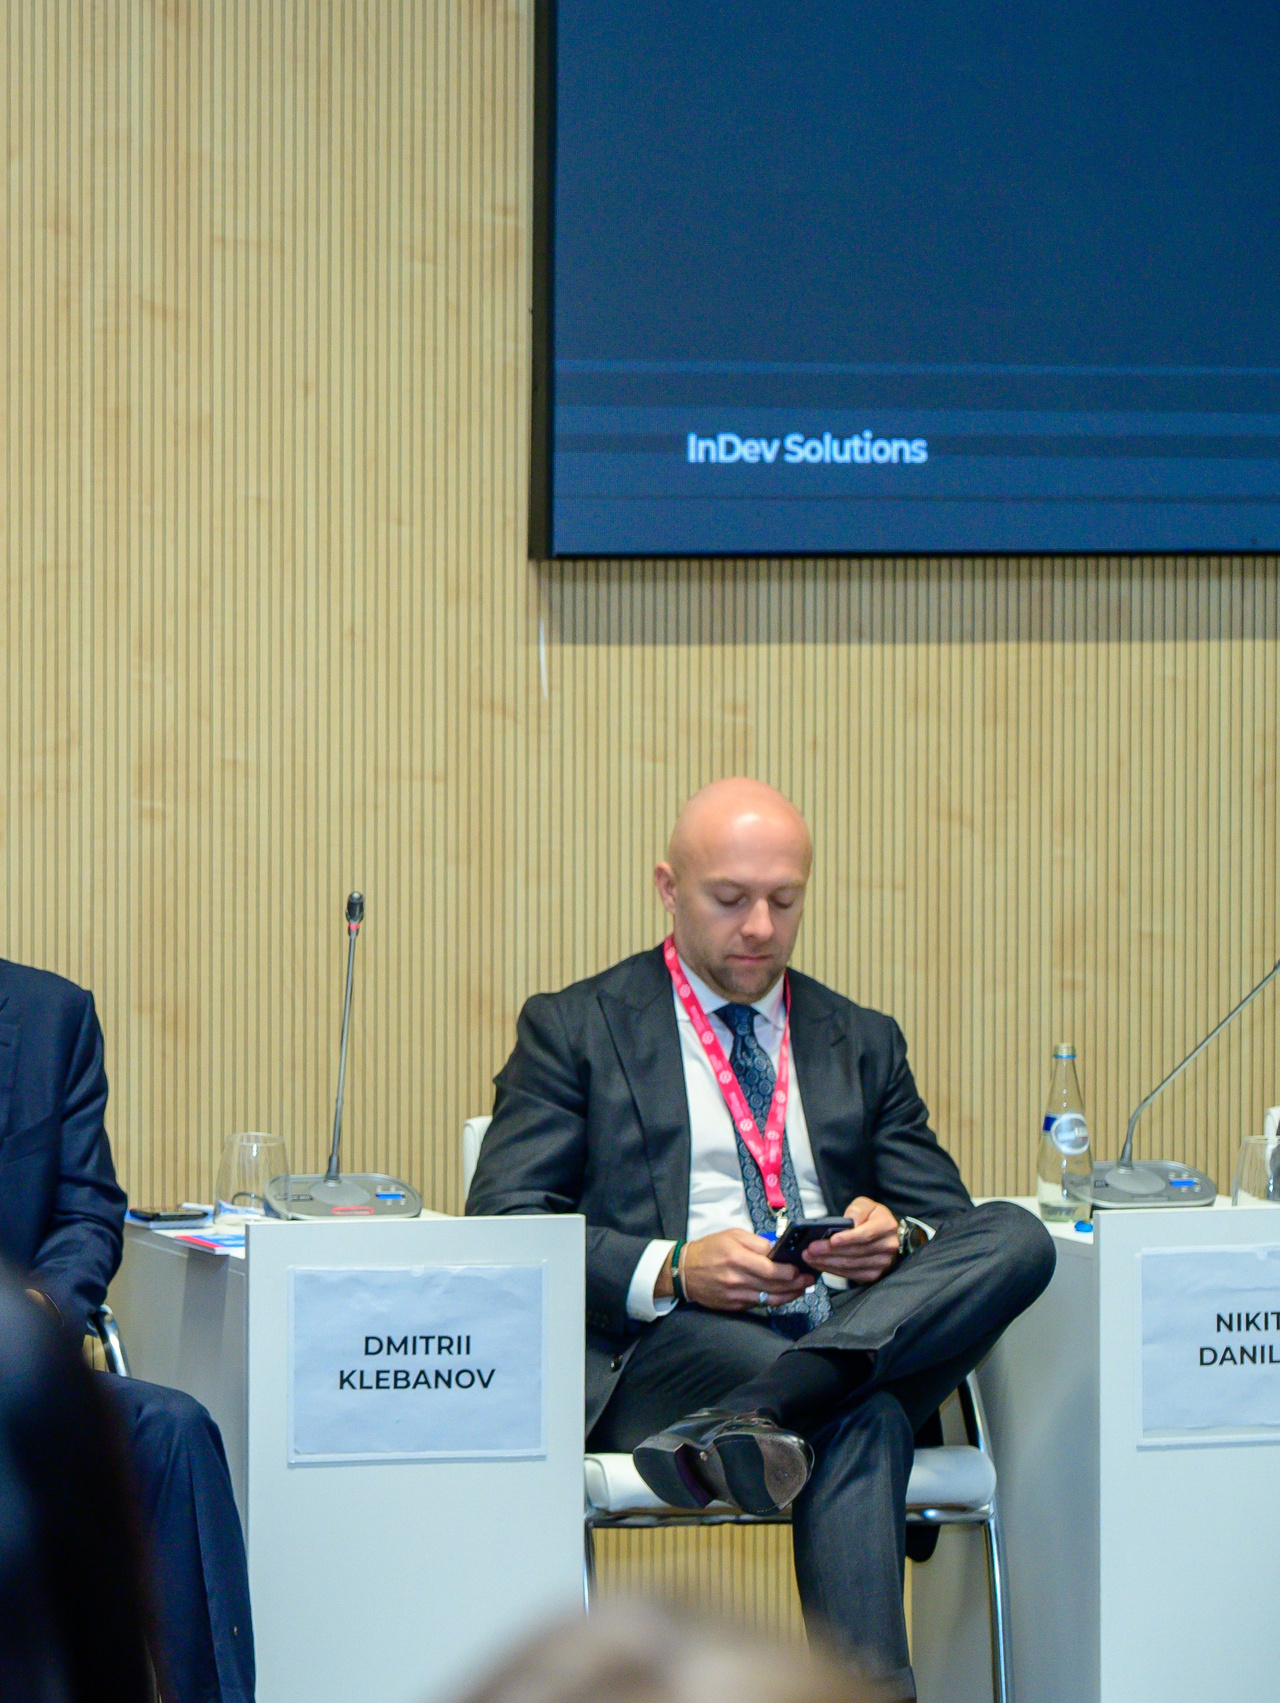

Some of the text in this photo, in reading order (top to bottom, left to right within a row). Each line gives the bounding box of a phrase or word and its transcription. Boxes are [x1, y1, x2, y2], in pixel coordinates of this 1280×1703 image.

[687, 428, 928, 464] InDev Solutions
[363, 1335, 471, 1356] DMITRII
[1199, 1344, 1280, 1367] DANIL
[339, 1368, 496, 1390] KLEBANOV
